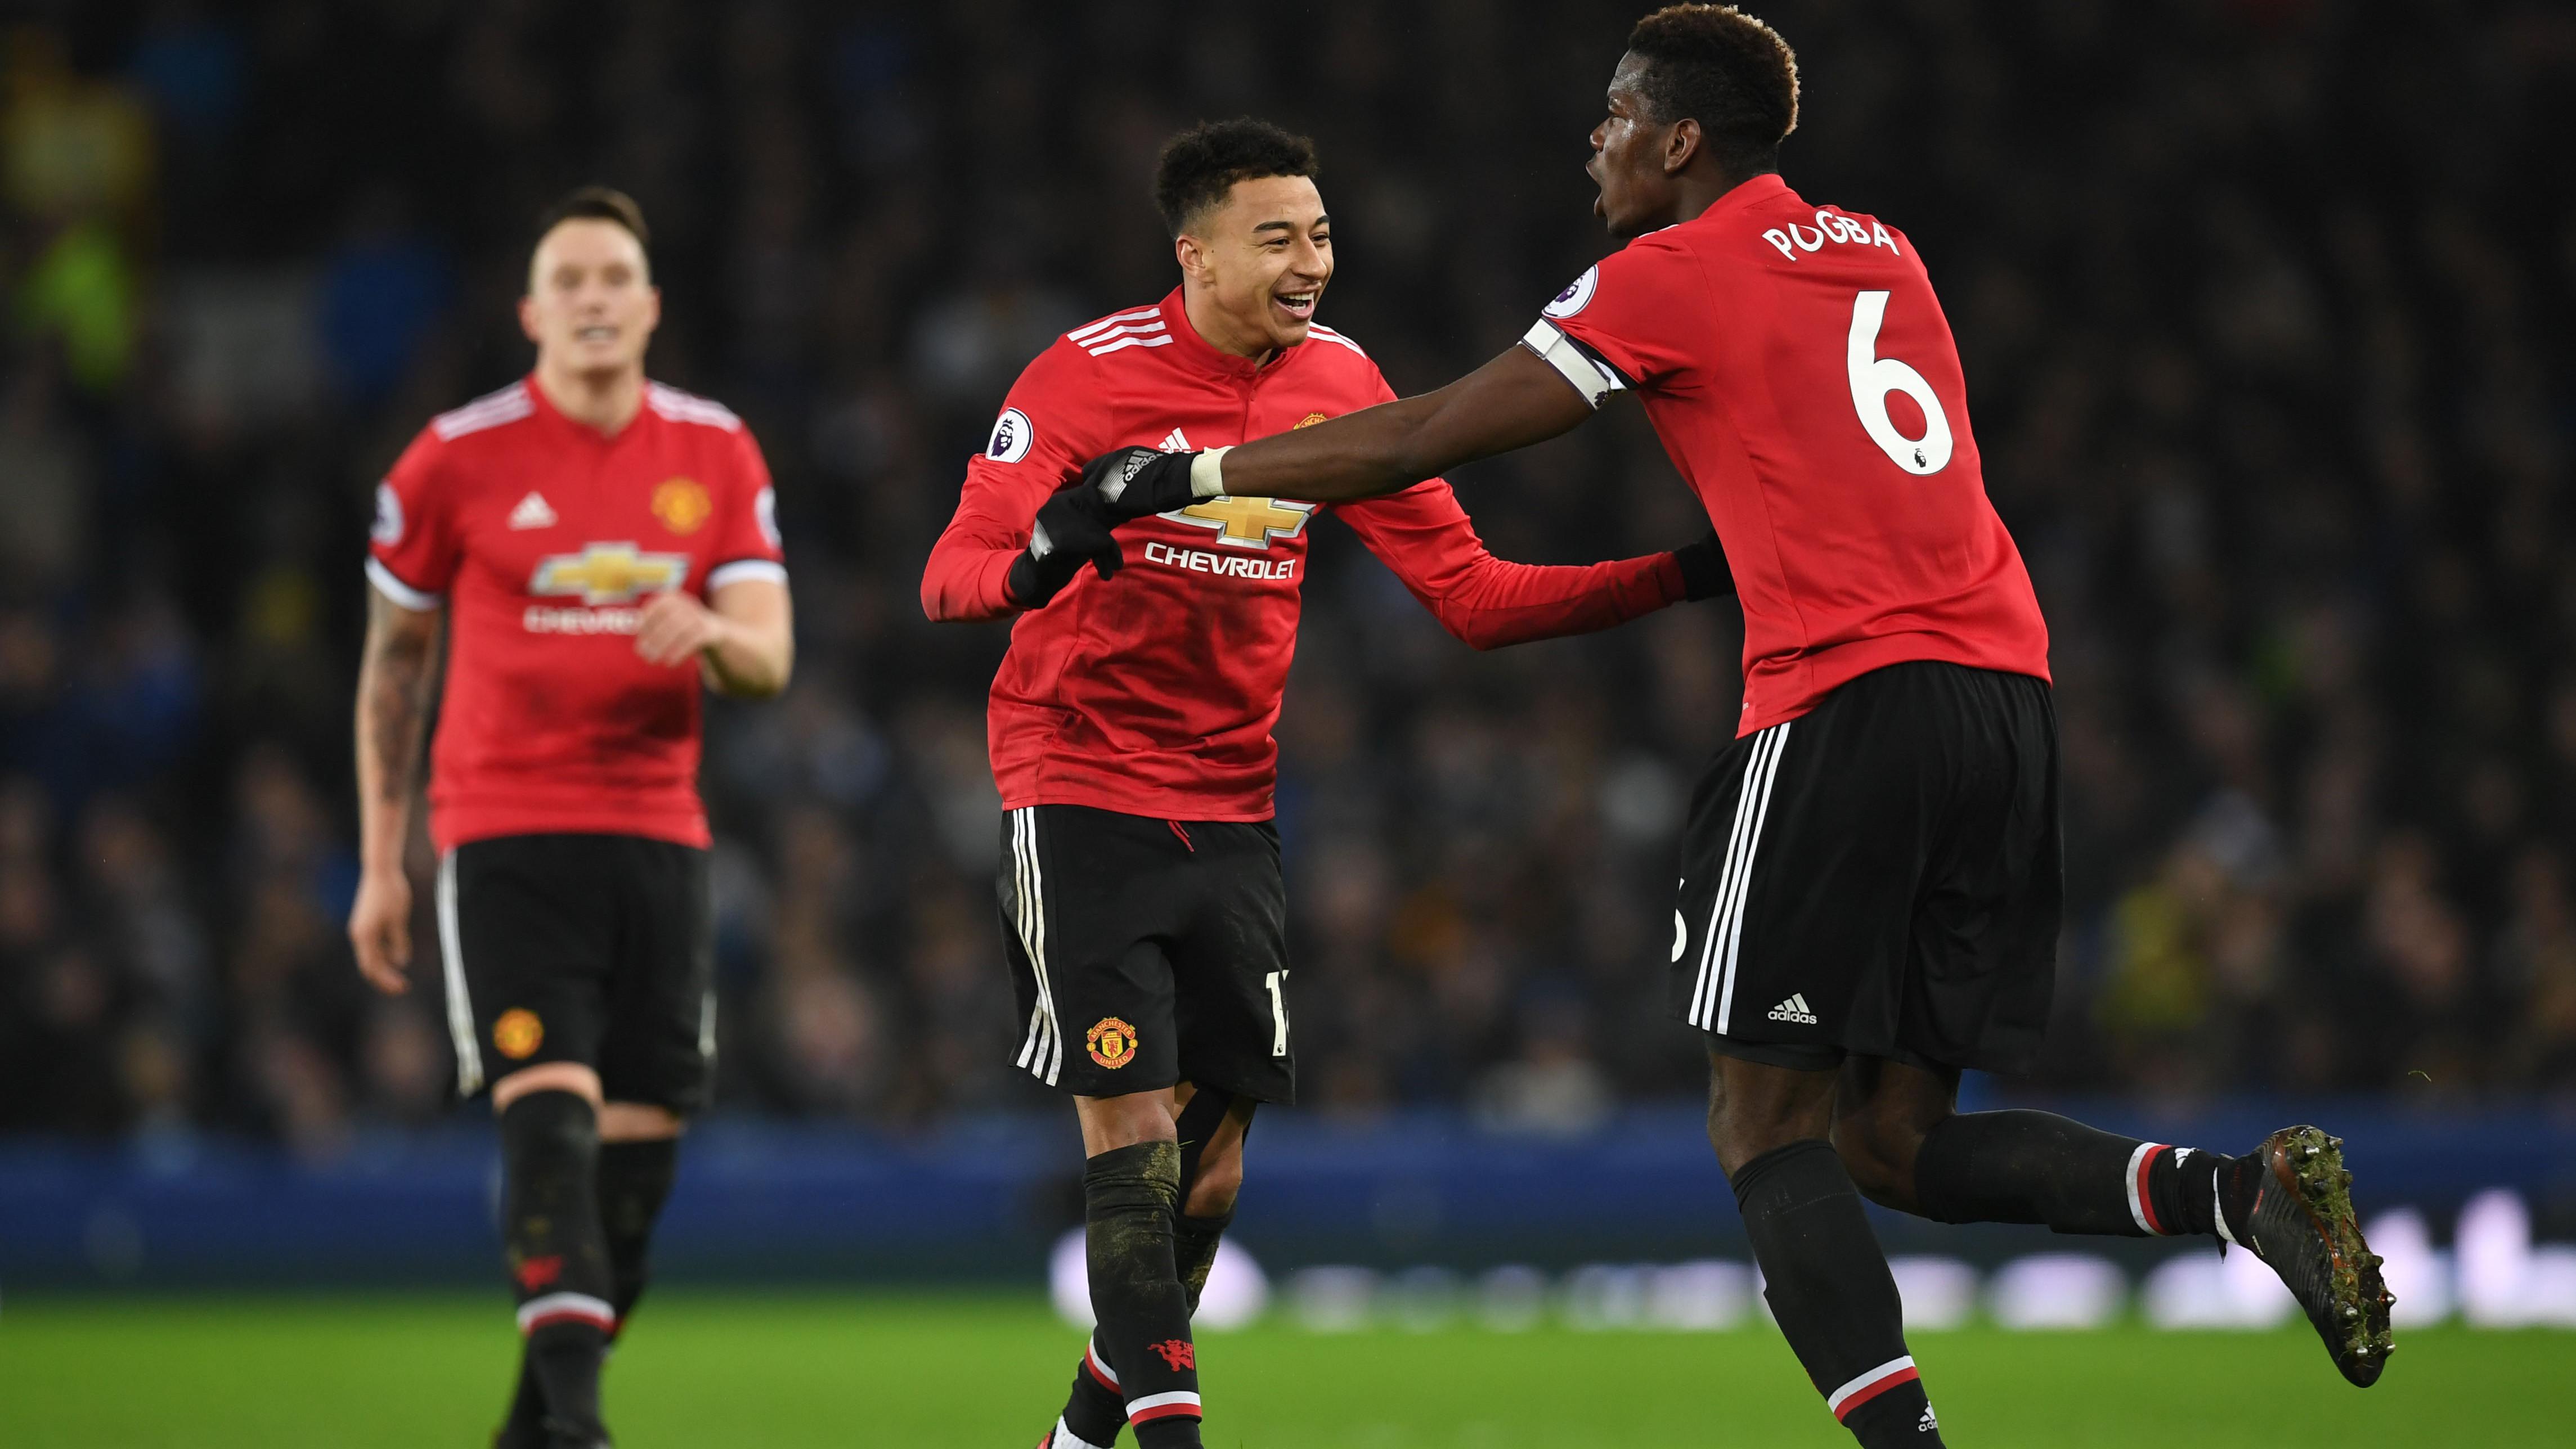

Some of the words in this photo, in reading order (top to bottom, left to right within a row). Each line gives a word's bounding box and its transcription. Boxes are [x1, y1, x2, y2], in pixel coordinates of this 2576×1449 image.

[1762, 210, 1900, 261] POGBA
[1847, 290, 1953, 476] 6
[1144, 542, 1296, 580] CHEVROLET
[1091, 1020, 1132, 1038] MANCHESTER
[1768, 1010, 1817, 1024] adidas
[1099, 1055, 1128, 1065] UNITED
